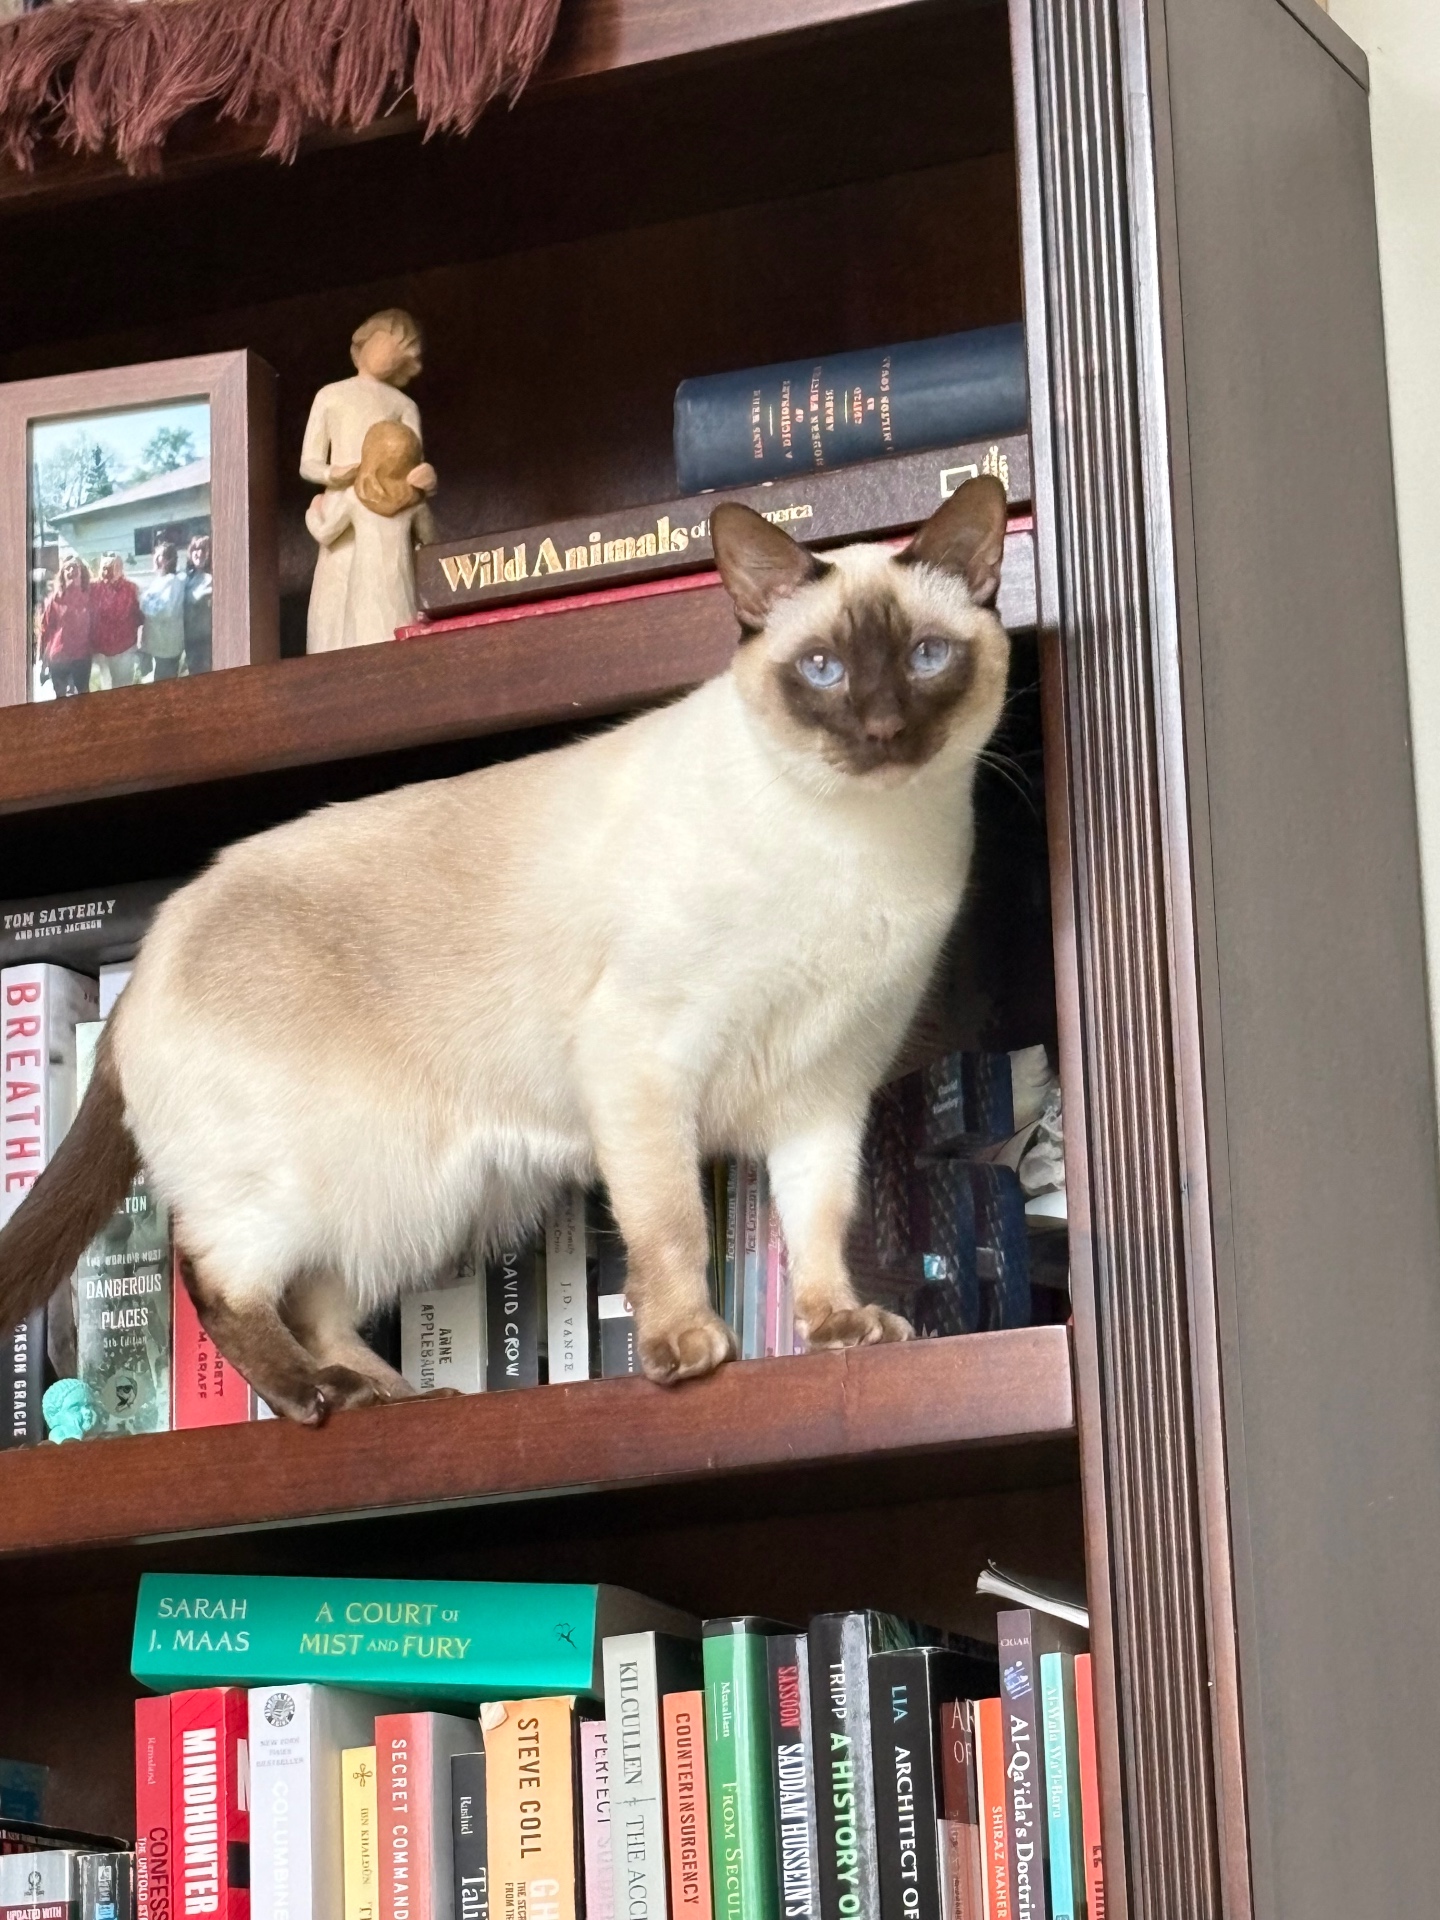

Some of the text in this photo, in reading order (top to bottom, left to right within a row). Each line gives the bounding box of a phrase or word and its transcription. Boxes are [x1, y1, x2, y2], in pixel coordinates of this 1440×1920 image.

[438, 543, 529, 592] Wild
[530, 515, 689, 577] Animals
[761, 502, 813, 525] merica
[4, 900, 116, 929] TOM SATTERLY
[15, 919, 102, 941] AND STEVE JACKSON
[6, 982, 41, 1193] BREATHE
[142, 1249, 161, 1263] MOST
[86, 1273, 162, 1299] DANGEROUS
[101, 1307, 149, 1329] PLACES
[502, 1252, 521, 1377] DAVID CROW
[420, 1304, 435, 1389] APPLEBAUM
[438, 1328, 452, 1365] ANNE
[563, 1317, 574, 1371] VANCE
[198, 1352, 207, 1398] GRAFF
[13, 1380, 27, 1437] GRACIE
[157, 1597, 247, 1621] SARAH
[315, 1602, 459, 1626] A COURT OF
[148, 1630, 250, 1653] J. MAAS
[300, 1633, 472, 1660] MIST AND FURY
[828, 1660, 847, 1719] TRIPP
[891, 1685, 908, 1724] LIA
[619, 1661, 643, 1784] KILCULLEN
[830, 1732, 852, 1751] A
[517, 1717, 542, 1859] STEVE COLL
[777, 1665, 812, 1917] SASSOON SADDAM HUSSEIN'S
[1007, 1715, 1033, 1837] Al-Qa'ida's
[183, 1727, 219, 1915] MINDHUNTER
[360, 1808, 369, 1826] IBN
[391, 1739, 410, 1920] SECRET COMMAND
[460, 1796, 473, 1835] Rashid
[675, 1712, 699, 1904] COUNTERINSURGENCY
[722, 1782, 738, 1839] FROM
[831, 1761, 859, 1889] HISTORY
[895, 1746, 918, 1882] ARCHITECT
[138, 1837, 147, 1854] THE
[272, 1781, 289, 1920] COLUMBINE
[625, 1815, 646, 1863] THE
[992, 1805, 1007, 1919] SHIRAZ MAHER
[138, 1857, 148, 1901] UNTOLD
[505, 1882, 515, 1907] FROM
[517, 1881, 526, 1897] THE
[42, 1906, 62, 1919] WITH
